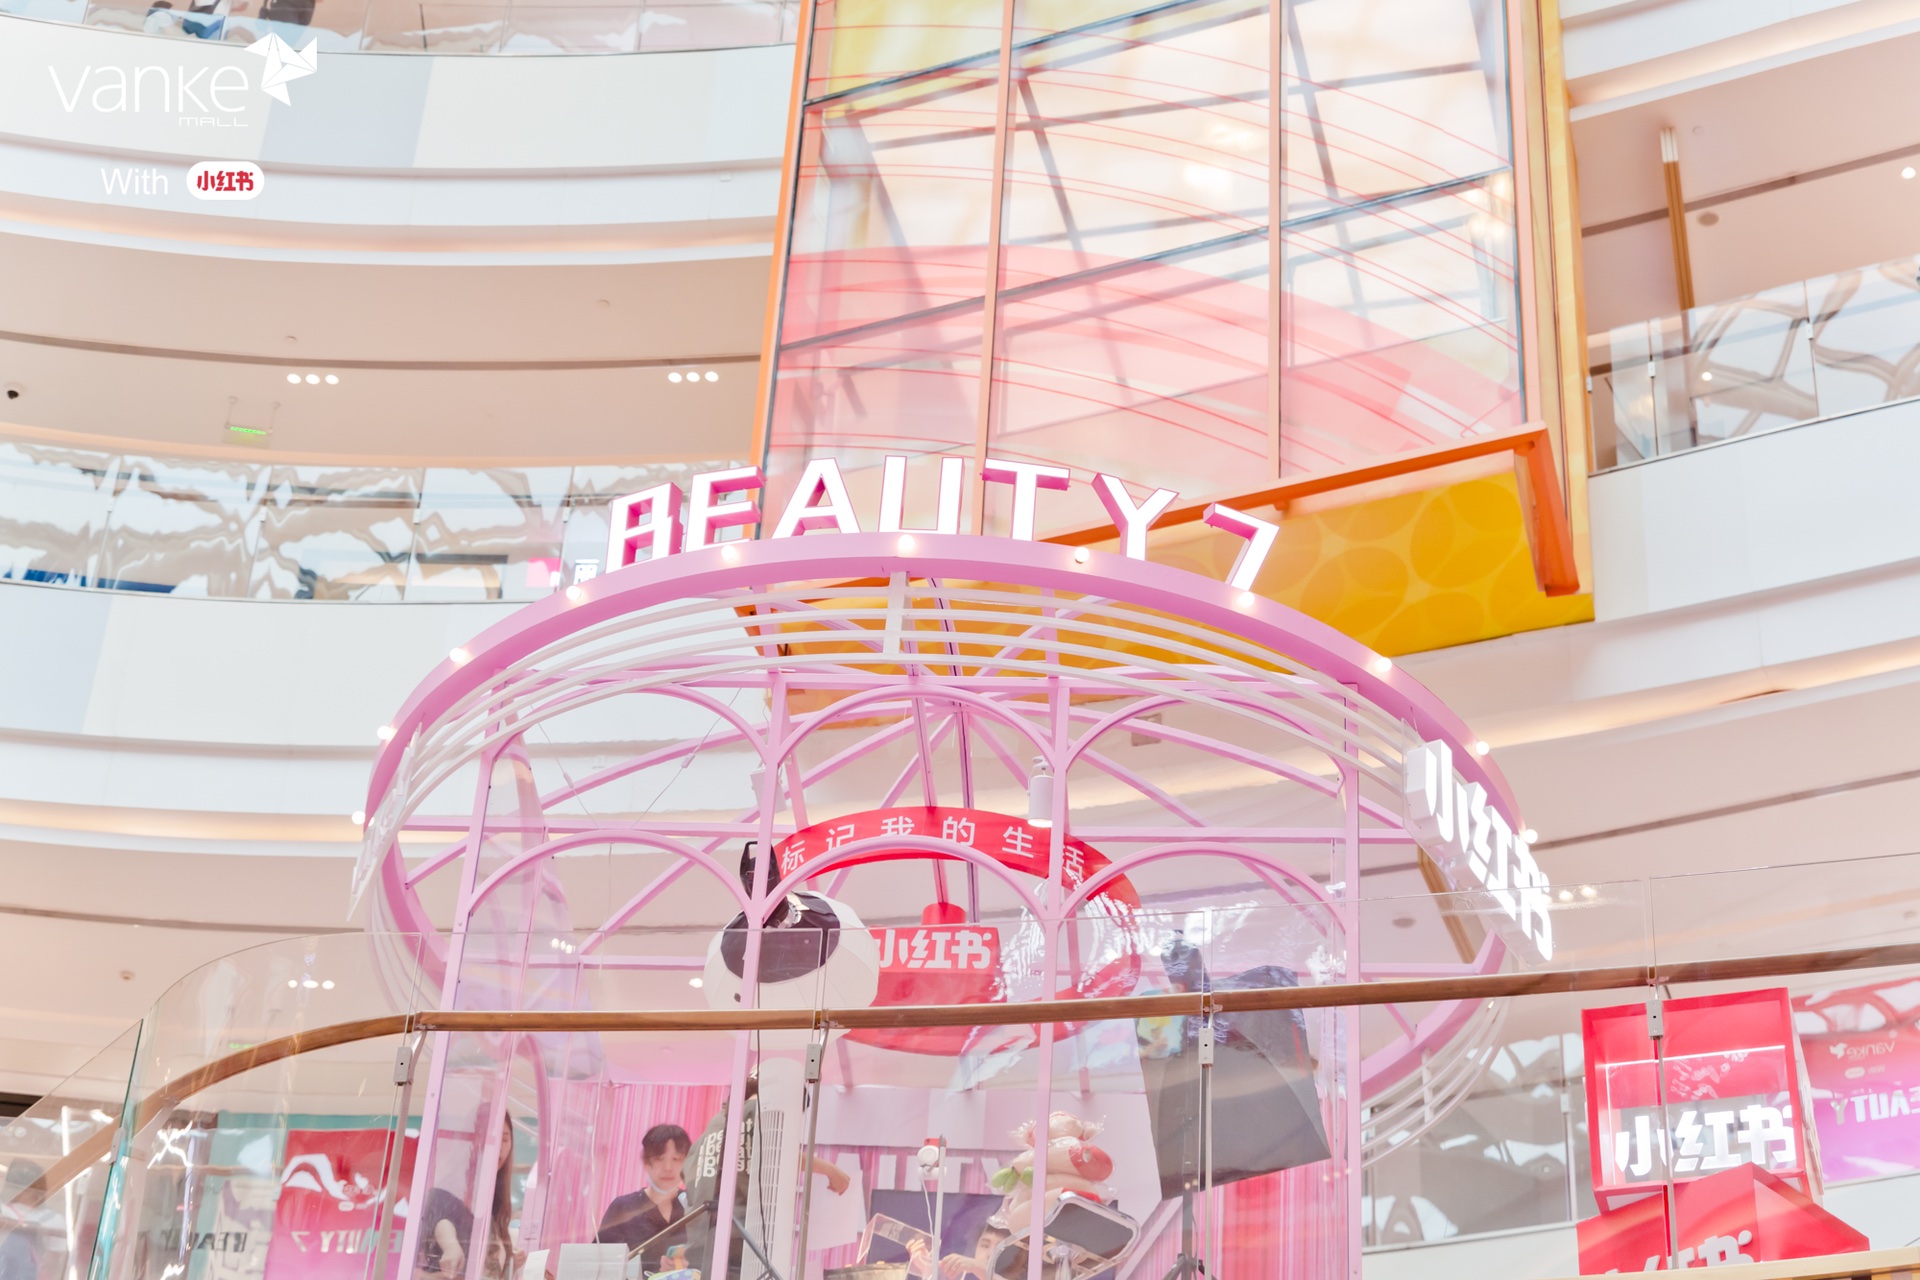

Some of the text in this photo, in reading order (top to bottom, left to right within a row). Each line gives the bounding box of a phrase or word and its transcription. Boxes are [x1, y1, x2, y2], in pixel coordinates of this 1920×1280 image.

[604, 455, 1280, 592] BEAUTY 7
[780, 814, 1085, 879] 标记我的生活
[1422, 738, 1554, 962] 小红书
[879, 928, 993, 970] 小红书
[1614, 1104, 1797, 1177] 小红书
